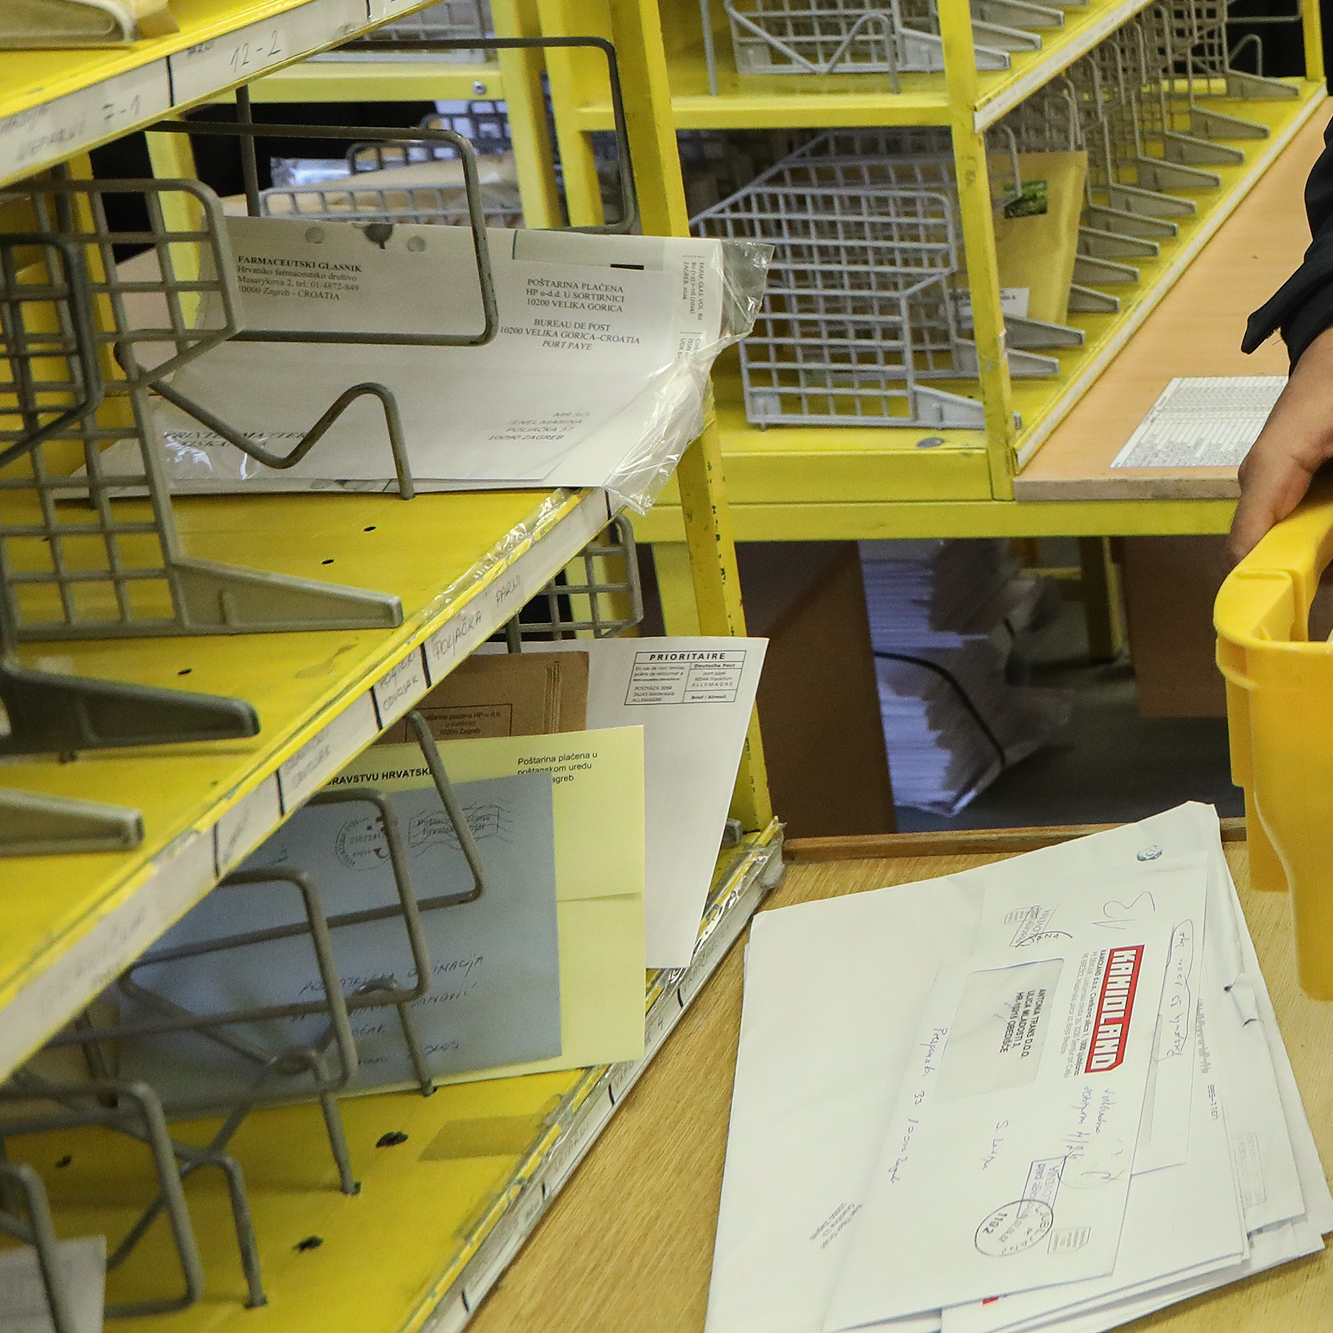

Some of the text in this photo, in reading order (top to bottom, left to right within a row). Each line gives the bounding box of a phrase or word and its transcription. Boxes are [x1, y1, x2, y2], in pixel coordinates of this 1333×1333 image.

[238, 256, 362, 272] FARMACEUTSKI GLASNIK
[238, 266, 357, 281] Hrvatsko farmaceutsko društvo
[238, 276, 284, 287] Masarykova
[527, 278, 624, 293] POŠTARINA PLAĆENA
[263, 287, 290, 297] Zagreb
[297, 291, 340, 300] CROATIA
[526, 288, 538, 296] HP
[572, 292, 625, 303] SORTIRNICI
[527, 298, 623, 313] 10200 VELIKA GORICA
[534, 318, 611, 332] BUREAU DE POST
[525, 328, 558, 338] VELIKA
[542, 340, 593, 350] PORT PAYE
[649, 653, 726, 661] PRIORITAIRE
[517, 755, 556, 765] Poštarina
[558, 753, 591, 763] plaćena
[569, 762, 592, 771] uredu
[552, 774, 574, 784] agreb
[1033, 988, 1046, 1016] ANTONIA
[1014, 989, 1036, 1042] ULICA MLADOSTI
[1090, 948, 1138, 1071] KAMIOLAND
[1026, 1016, 1039, 1038] TRANS
